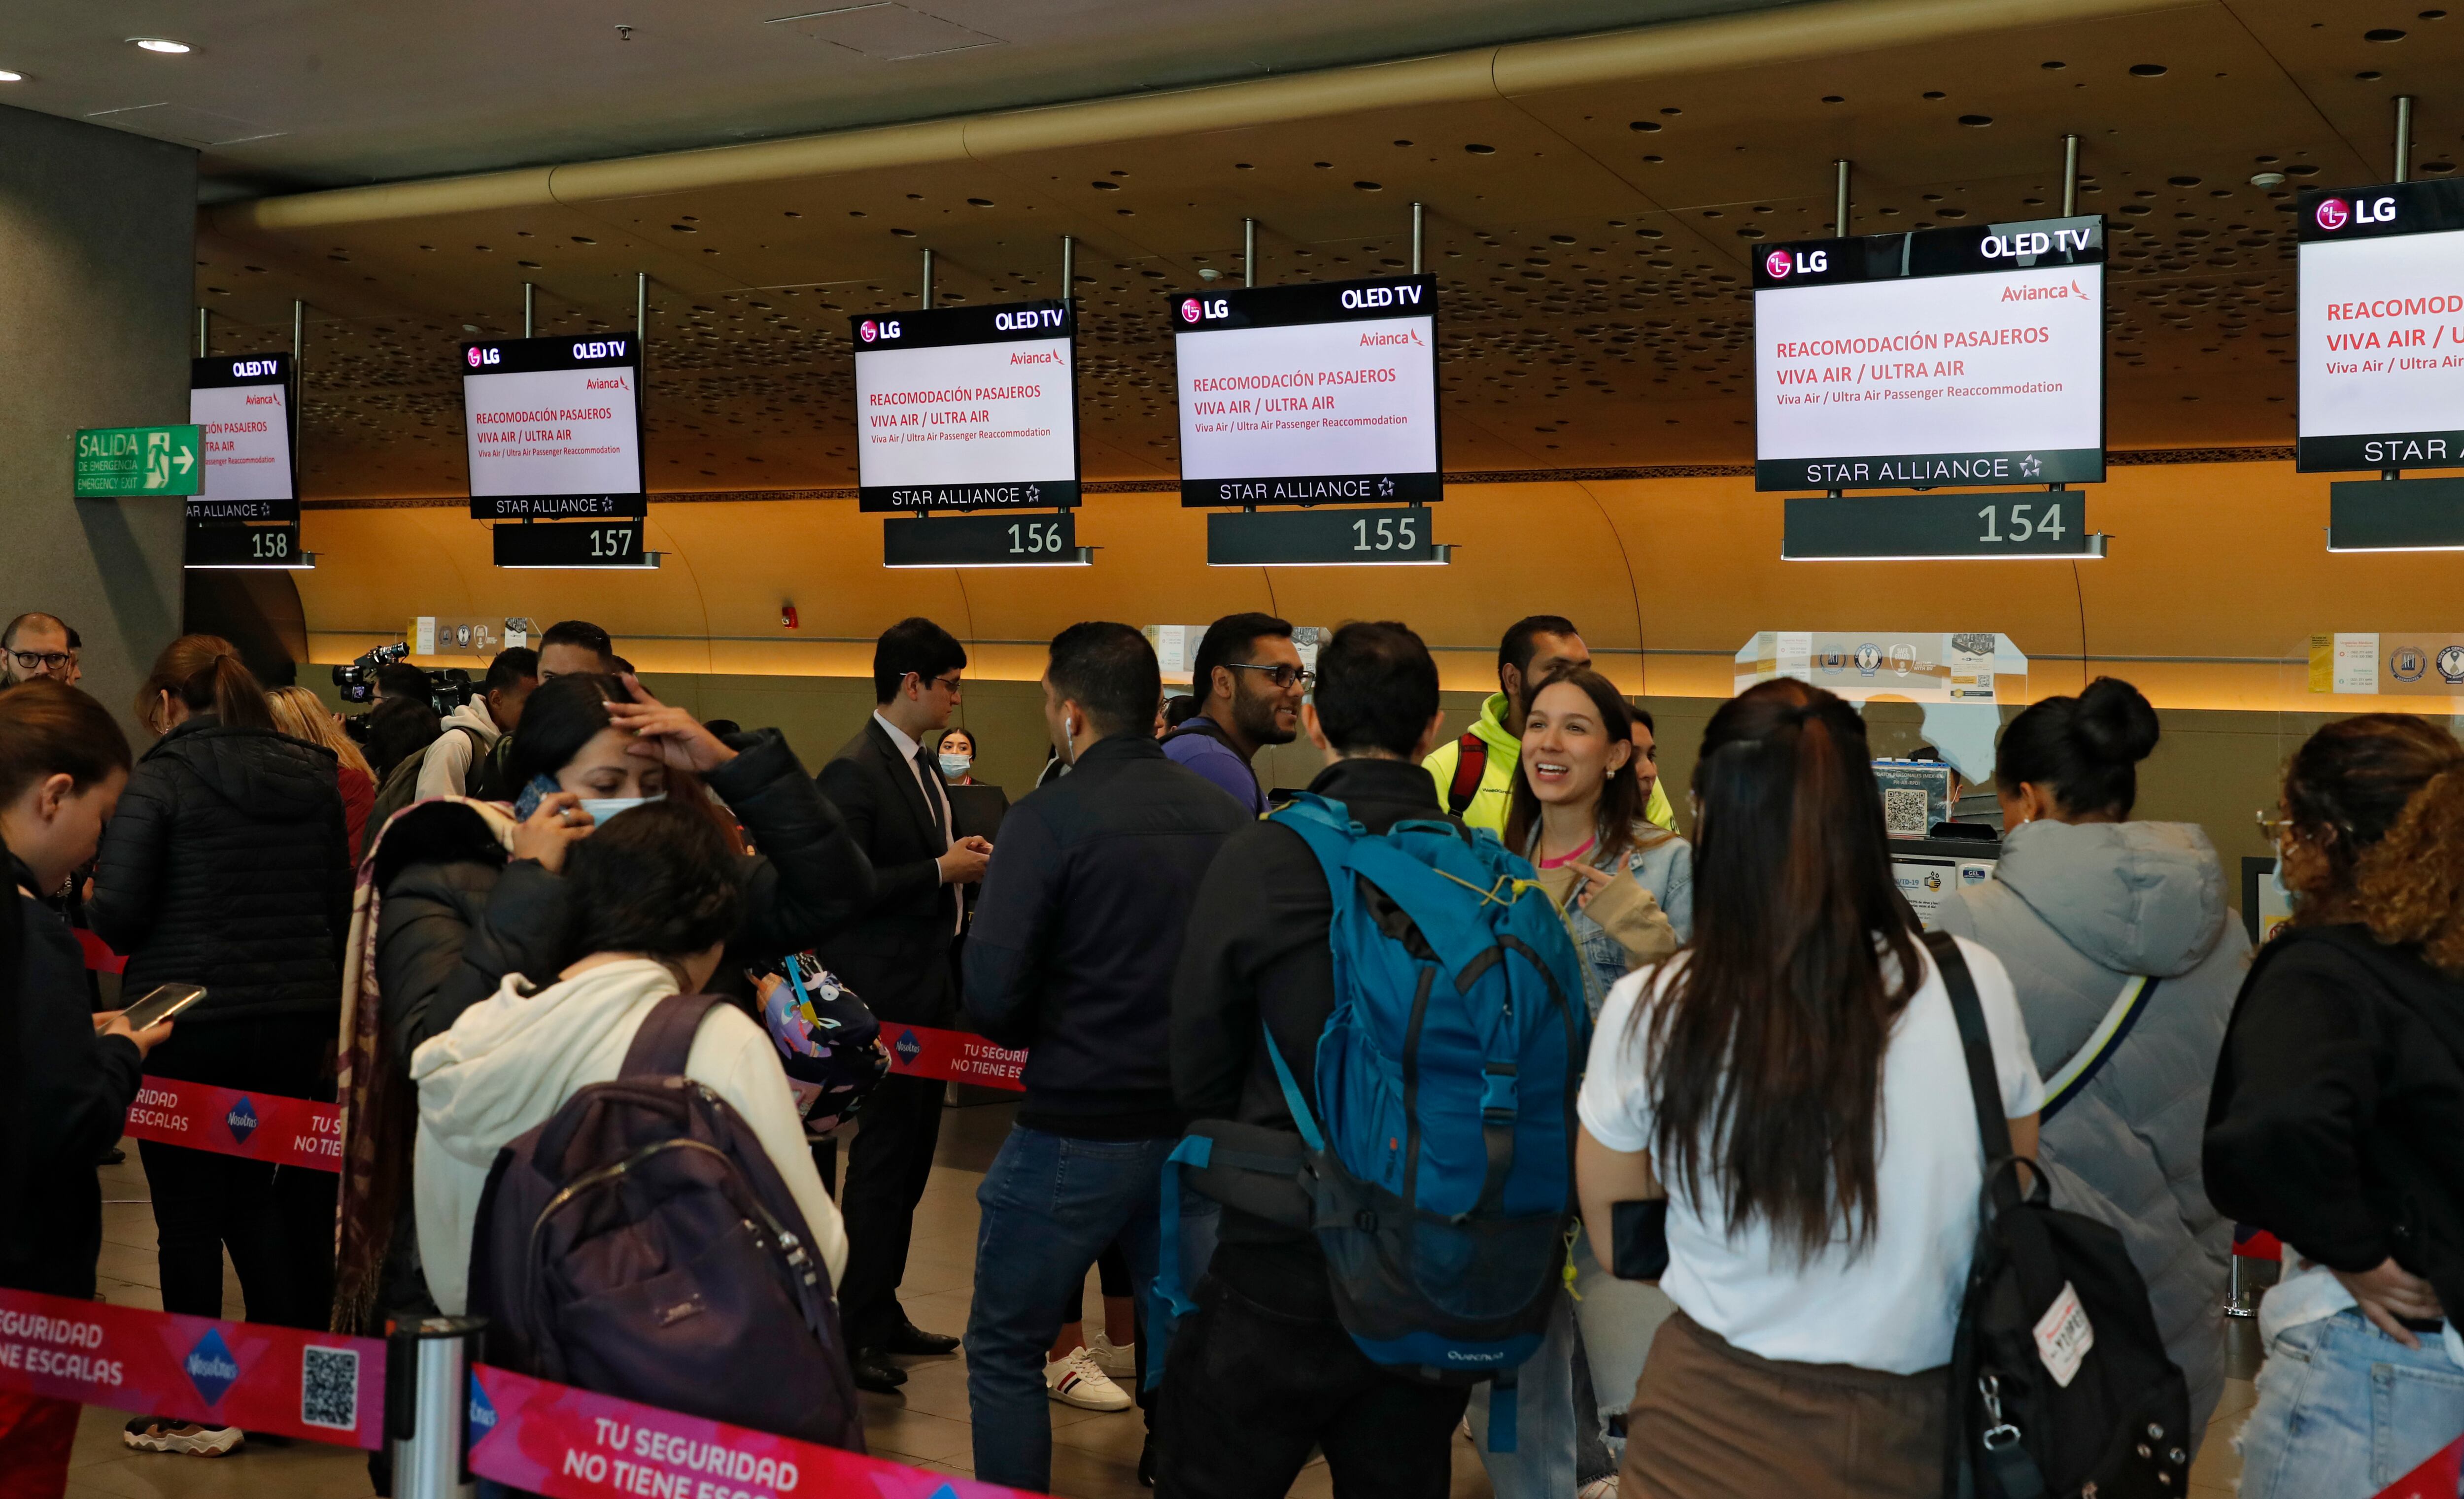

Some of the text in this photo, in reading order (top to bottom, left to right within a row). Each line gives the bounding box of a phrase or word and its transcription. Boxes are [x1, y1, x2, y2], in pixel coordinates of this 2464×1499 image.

[2356, 197, 2396, 224] LG
[1981, 228, 2090, 259] OLED TV
[1796, 251, 1827, 273] LG
[1341, 285, 1421, 309] OLED TV
[2001, 284, 2068, 302] Avianca
[1204, 300, 1228, 319] LG
[995, 309, 1062, 331] OLED TV
[880, 321, 900, 339] LG
[1360, 333, 1408, 346] Avianca
[2327, 332, 2381, 352] VIVA
[2388, 329, 2426, 347] AIR
[2432, 326, 2445, 349] /
[573, 341, 625, 359] OLED TV
[1778, 326, 2050, 358] REACOMODACIÓN PASAJEROS
[482, 348, 500, 364] LG
[1010, 352, 1051, 365] Avianca
[2327, 354, 2464, 375] Viva Air / Ultra Air
[233, 361, 276, 377] OLED TV
[1777, 360, 1964, 385] VIVA AIR / ULTRA AIR
[587, 378, 618, 389] Avianca
[1194, 368, 1396, 392] REACOMODACIÓN PASAJEROS
[246, 395, 272, 405] Avianca
[870, 385, 1041, 406] REACOMODACIÓN PASAJEROS
[1777, 381, 2063, 406] Viva Air / Ultra Air Passenger Reaccommodation
[1195, 396, 1335, 415] VIVA AIR / ULTRA AIR
[477, 408, 611, 424] REACOMODACIÓN PASAJEROS
[871, 410, 990, 427] VIVA AIR / ULTRA AIR
[1195, 414, 1407, 433] Viva Air / Ultra Air Passenger Reaccommodation
[225, 422, 267, 432] PASAJEROS
[478, 429, 571, 443] VIVA AIR / ULTRA AIR
[871, 428, 1050, 444] Viva Air / Ultra Air Passenger Reaccommodation
[79, 434, 138, 457] SALIDA
[222, 442, 234, 450] AIR
[502, 449, 505, 458] /
[506, 448, 521, 457] Ultra
[533, 447, 562, 457] Passenger
[564, 446, 619, 454] Reaccommodation
[2365, 439, 2447, 462] STAR
[79, 460, 137, 471] DE EMERGENCIA
[228, 456, 274, 464] Reaccommodation
[1807, 459, 2009, 482] STAR ALLIANCE
[78, 477, 137, 490] EMERGENCY EXIT
[1220, 480, 1369, 500] STAR ALLIANCE
[497, 499, 597, 513] STAR ALLIANCE
[892, 488, 1020, 506] STAR ALLIANCE
[204, 505, 257, 516] ALLIANCE
[1978, 504, 2066, 542] 154
[590, 530, 631, 556] 157
[1008, 523, 1062, 553] 156
[1353, 517, 1415, 551] 155
[252, 533, 287, 557] 158
[2402, 654, 2414, 668] ACI
[2437, 650, 2446, 663] CHECK
[896, 1041, 920, 1054] Nosotras
[964, 1044, 979, 1056] TU
[951, 1058, 969, 1071] NO
[972, 1061, 1005, 1077] TIENE
[130, 1108, 188, 1131] ESCALAS
[228, 1112, 257, 1128] Nosotras
[312, 1116, 331, 1132] TU
[294, 1135, 342, 1157] NO TIE
[26, 1347, 123, 1386] ESCALAS
[595, 1417, 798, 1492] TU SEGURIDAD
[563, 1448, 607, 1483] NO
[614, 1459, 692, 1499] TIENE
